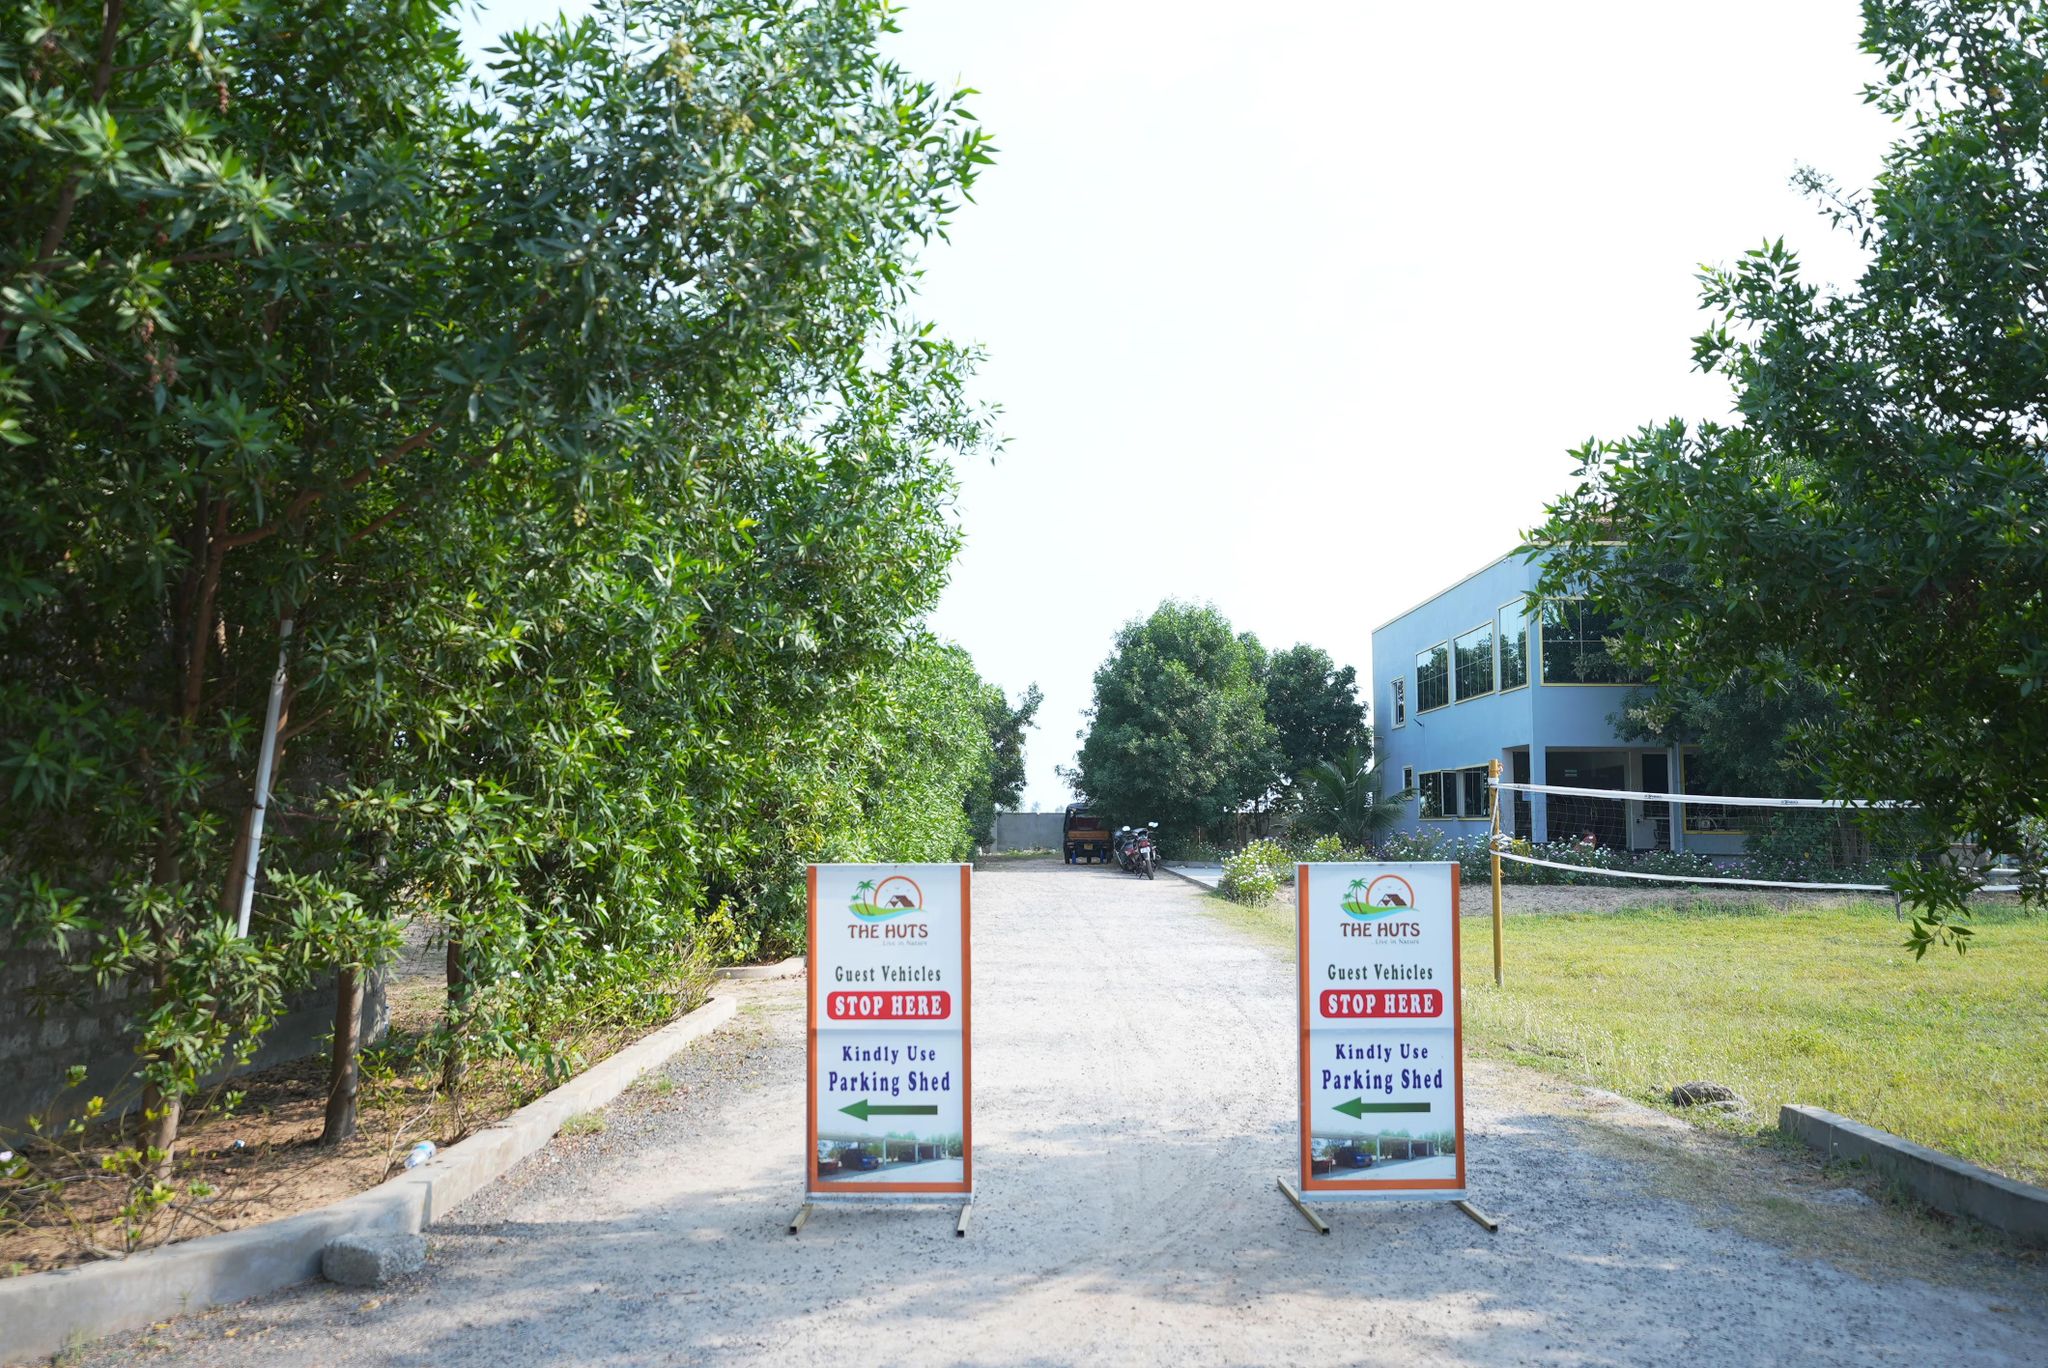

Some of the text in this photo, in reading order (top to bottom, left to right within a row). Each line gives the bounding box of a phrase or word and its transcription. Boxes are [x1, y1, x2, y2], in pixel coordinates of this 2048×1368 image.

[847, 923, 929, 939] THE HUTS
[1340, 922, 1421, 937] THE HUTS
[835, 965, 942, 982] Guest Vehicles
[1327, 963, 1433, 980] Guest Vehicles
[835, 995, 942, 1016] STOP HERE
[1328, 993, 1434, 1014] STOP HERE
[842, 1046, 936, 1065] Kindly Use
[1335, 1043, 1428, 1063] Kindly Use
[828, 1071, 951, 1097] Parking Shed
[1322, 1068, 1443, 1095] Parking Shed
